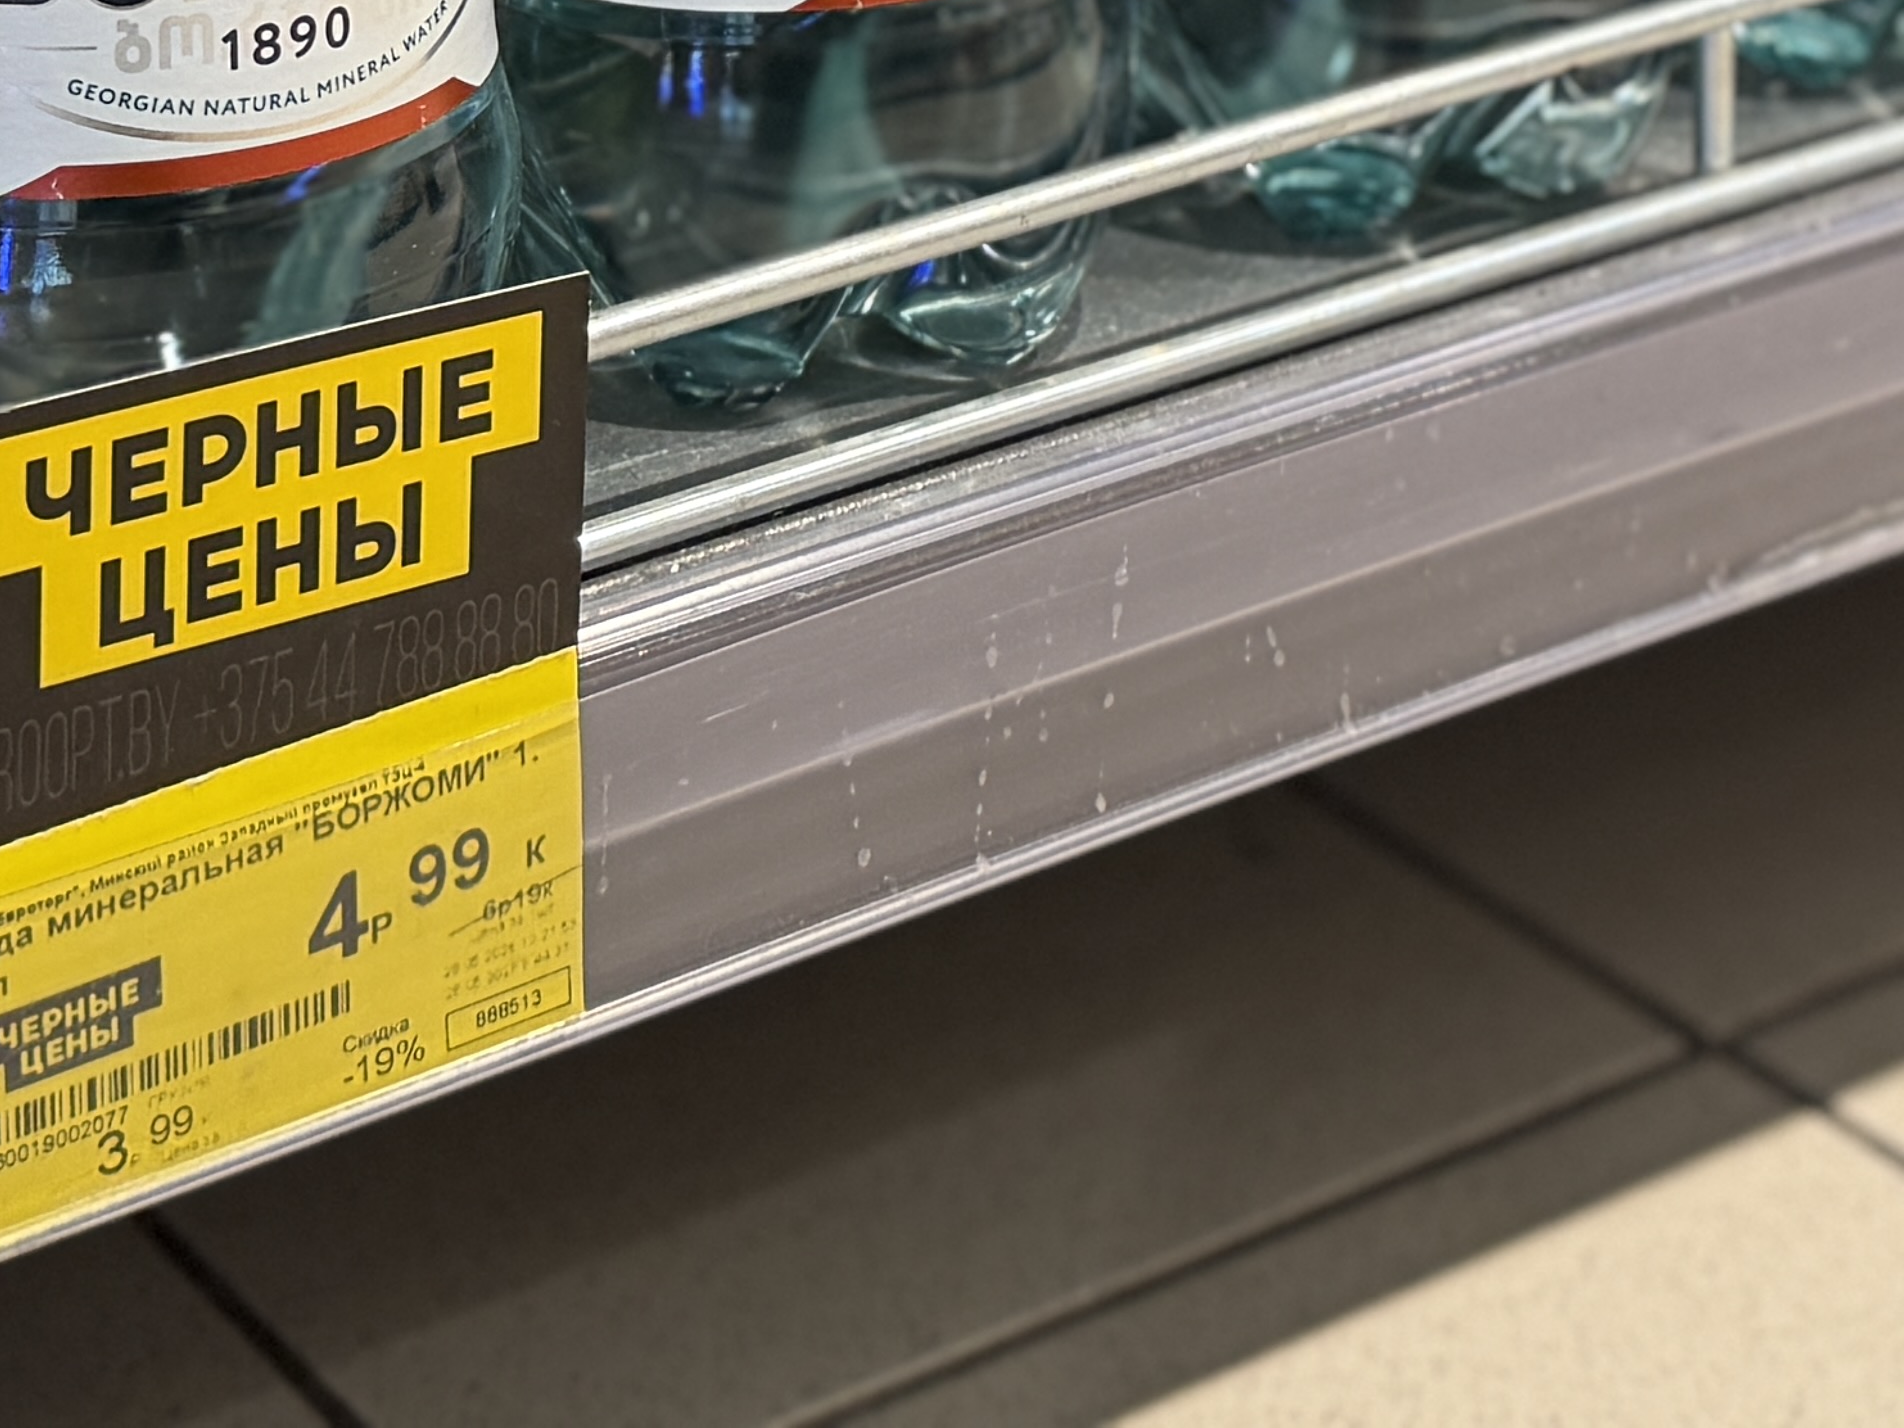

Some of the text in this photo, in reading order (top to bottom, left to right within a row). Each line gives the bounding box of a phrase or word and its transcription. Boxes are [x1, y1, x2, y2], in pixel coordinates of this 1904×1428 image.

[220, 5, 351, 72] 1890
[67, 78, 195, 116] GEORGIAN
[203, 87, 311, 116] NATURAL
[316, 46, 401, 100] MINERAL
[25, 348, 496, 535] ЧЕРНЫЕ
[98, 482, 423, 649] ЦЕНЫ
[194, 648, 295, 743] +375
[306, 632, 360, 712] 44
[373, 609, 446, 701] 788
[454, 593, 504, 681] 88
[512, 577, 560, 670] 80
[47, 834, 285, 938] минеральная
[294, 749, 500, 843] "БОРЖОМИ"
[513, 739, 540, 769] 1.
[89, 855, 162, 894] Минский
[166, 836, 216, 870] район
[408, 827, 491, 907] 99
[342, 1017, 411, 1054] Скидка
[475, 989, 542, 1029] 888513
[20, 1015, 120, 1076] ЦЕНЫ
[343, 1034, 426, 1085] -19%
[149, 1104, 194, 1145] 99
